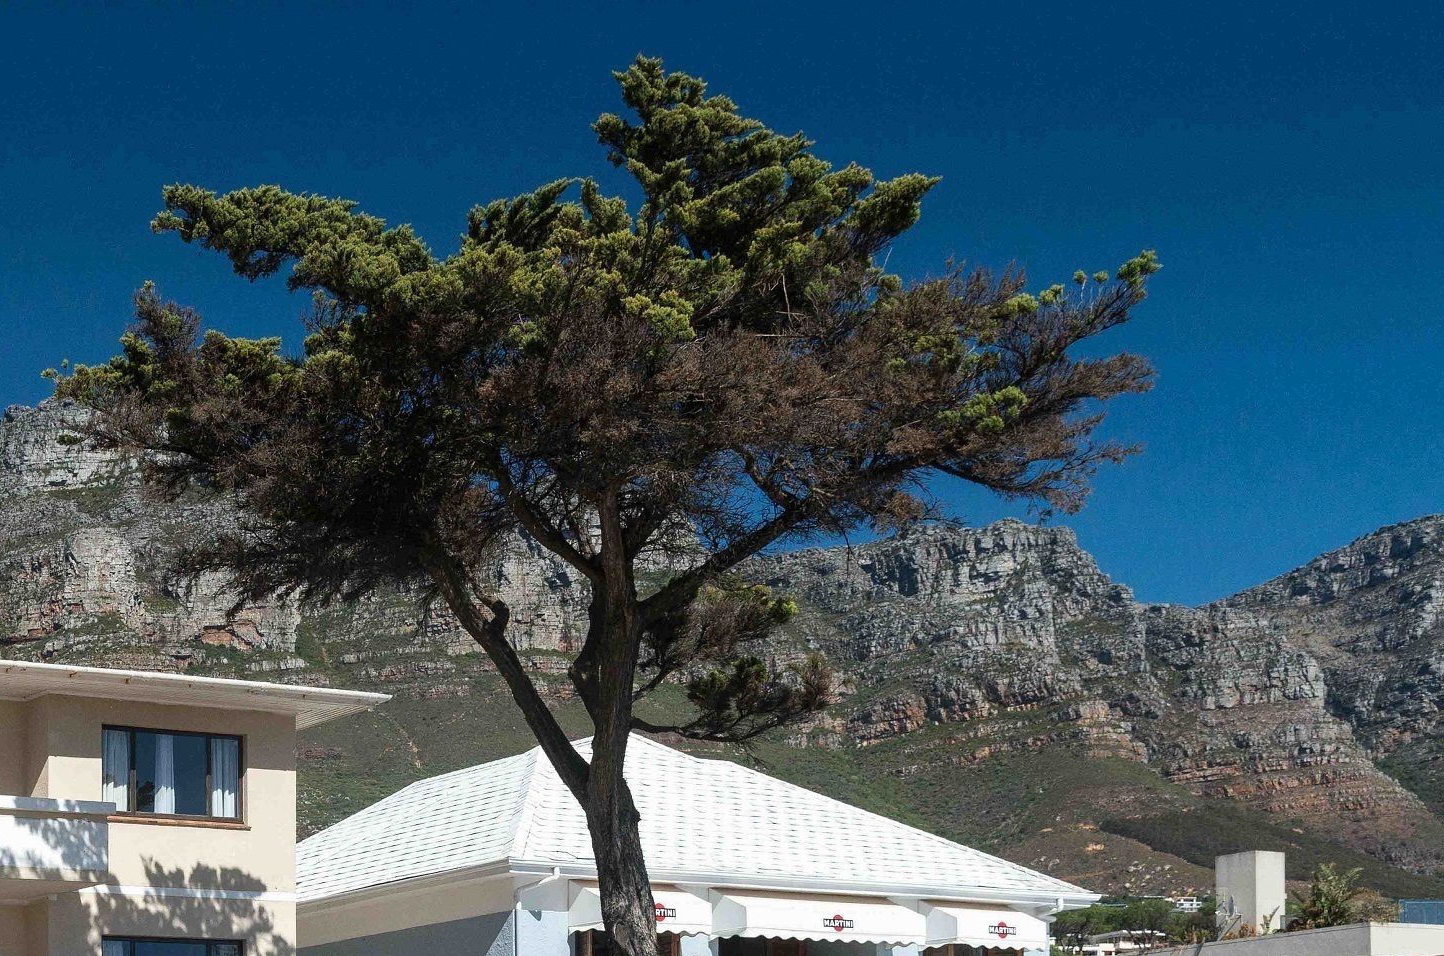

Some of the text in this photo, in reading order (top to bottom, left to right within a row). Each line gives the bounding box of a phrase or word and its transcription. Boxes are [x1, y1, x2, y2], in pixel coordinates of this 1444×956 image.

[655, 908, 676, 918] RTINI
[823, 918, 854, 929] MARTINI
[989, 925, 1016, 935] MARTINI
